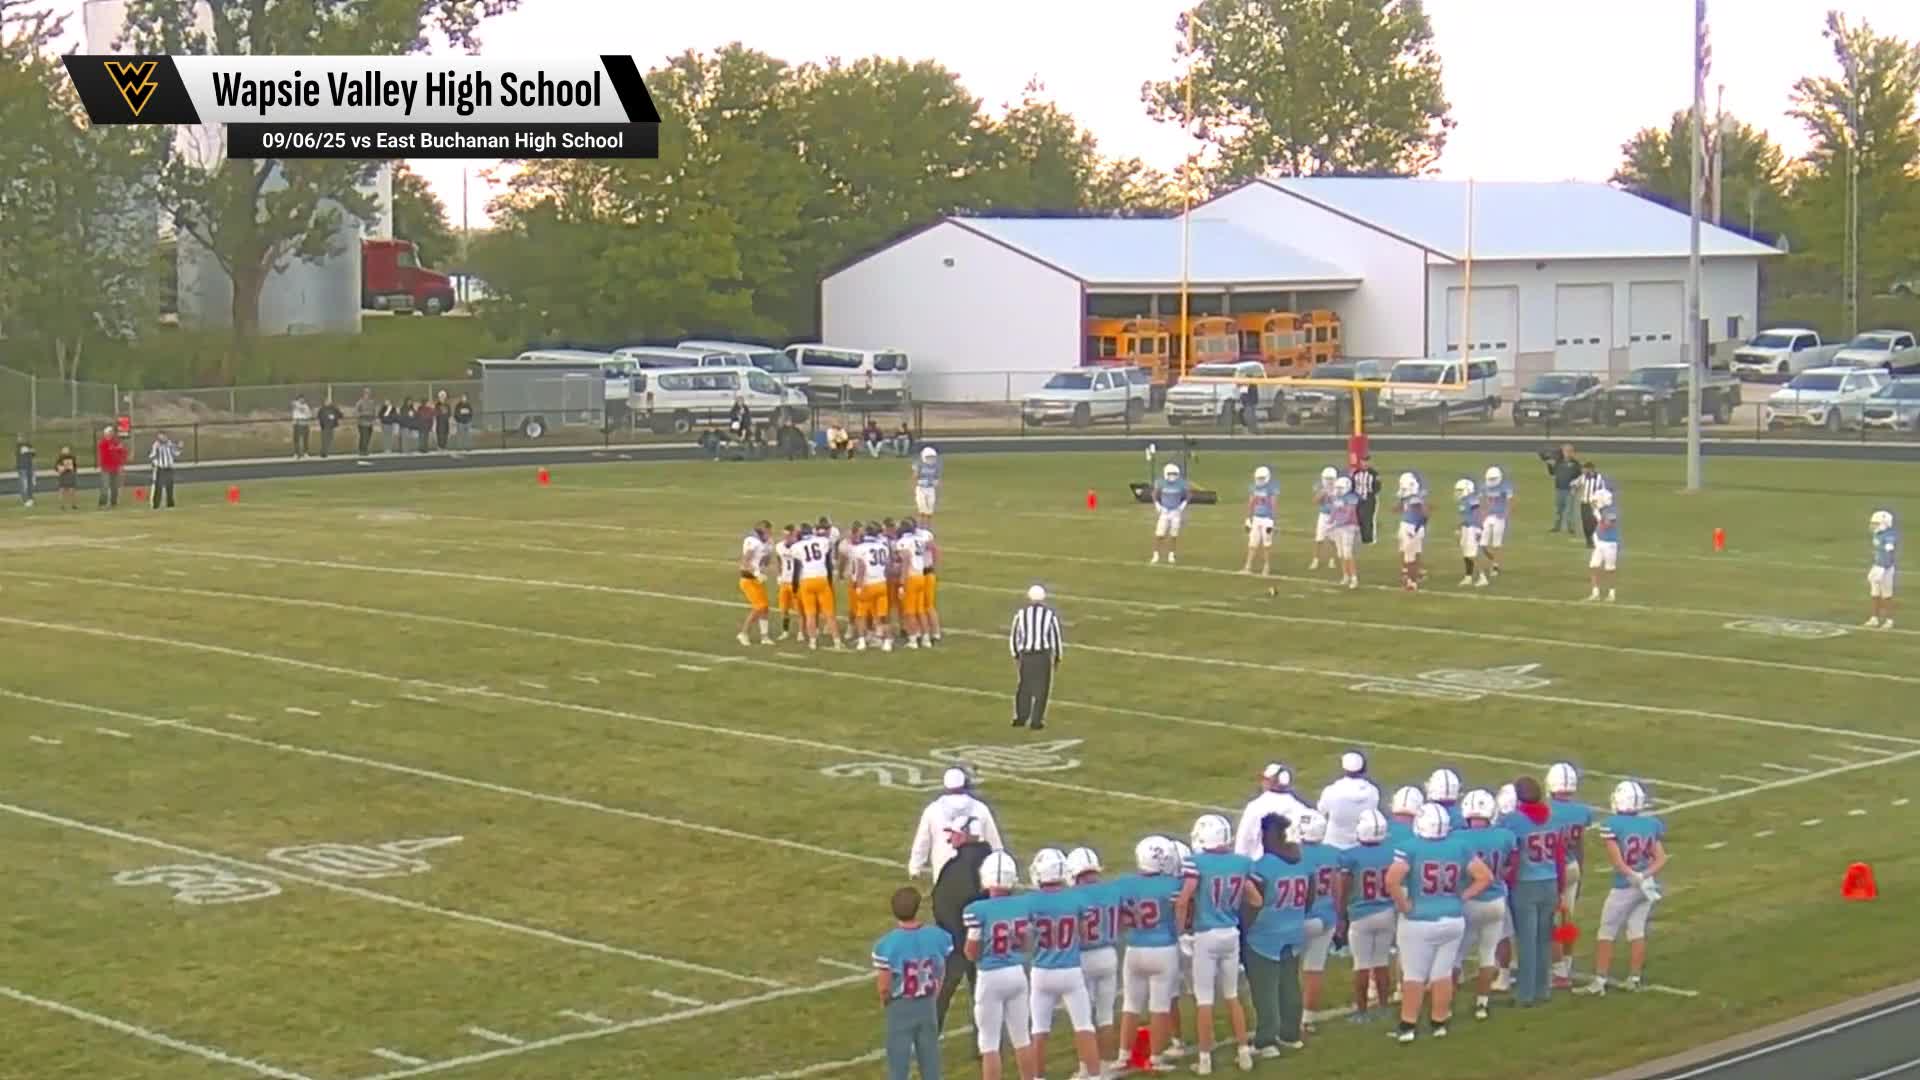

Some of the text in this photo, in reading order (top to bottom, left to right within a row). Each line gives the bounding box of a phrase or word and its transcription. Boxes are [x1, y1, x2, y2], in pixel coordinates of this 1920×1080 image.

[804, 542, 822, 562] 16
[868, 547, 888, 567] 30
[1527, 831, 1558, 863] 59
[1211, 874, 1244, 912] 17
[1275, 877, 1308, 911] 78
[1421, 861, 1461, 896] 53
[991, 918, 1029, 955] 65
[1035, 916, 1076, 950] 30
[1086, 905, 1117, 942] 21
[902, 958, 939, 998] 63
